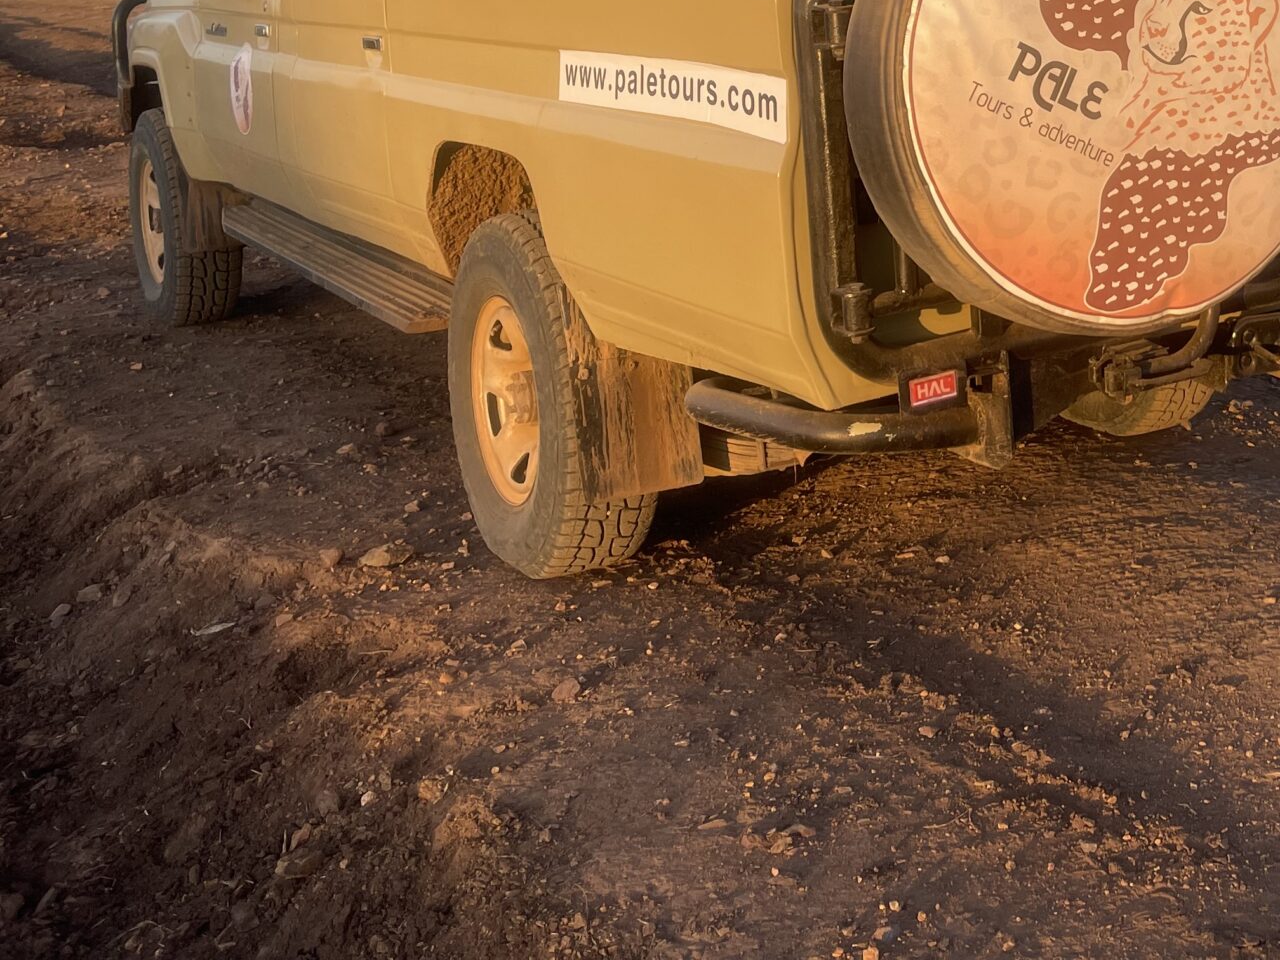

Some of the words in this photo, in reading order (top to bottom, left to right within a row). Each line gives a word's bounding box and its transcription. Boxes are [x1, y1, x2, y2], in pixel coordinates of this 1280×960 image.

[565, 63, 778, 123] www.paletours.com
[1007, 41, 1109, 120] PALE
[967, 80, 1014, 120] Tours
[1019, 107, 1034, 128] &
[1038, 120, 1115, 168] adventure
[917, 378, 951, 399] HAL
